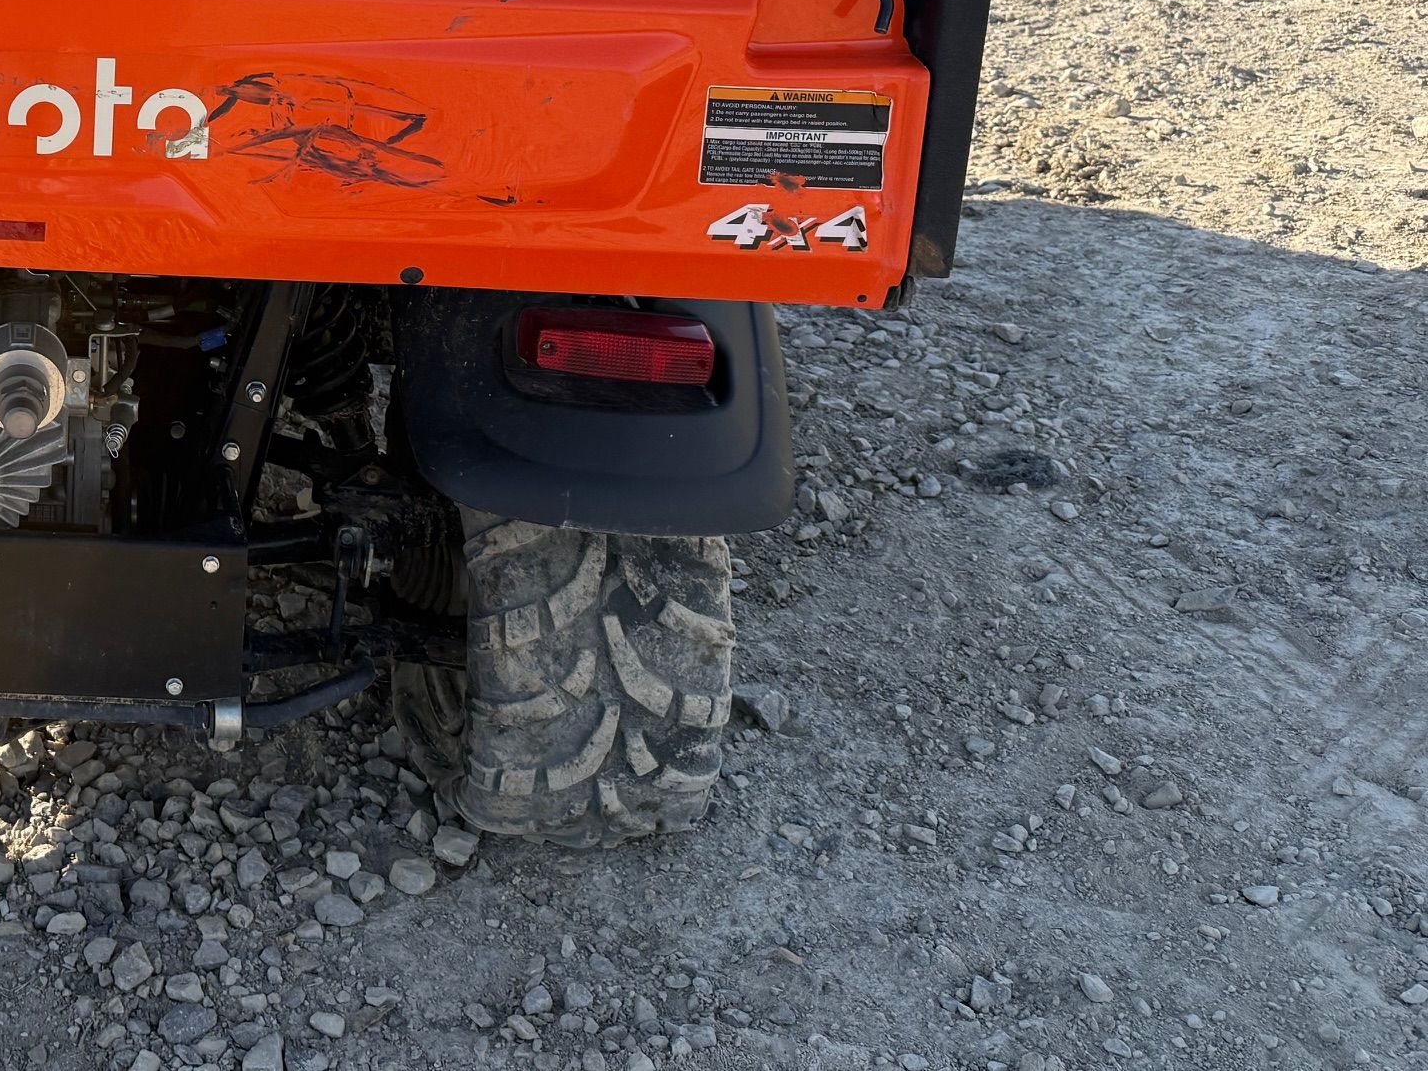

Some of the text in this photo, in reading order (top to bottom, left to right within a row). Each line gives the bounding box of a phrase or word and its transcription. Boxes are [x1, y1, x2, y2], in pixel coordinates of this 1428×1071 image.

[783, 92, 834, 102] WARNING
[766, 131, 828, 141] IMPORTANT
[706, 203, 868, 252] 4x4
